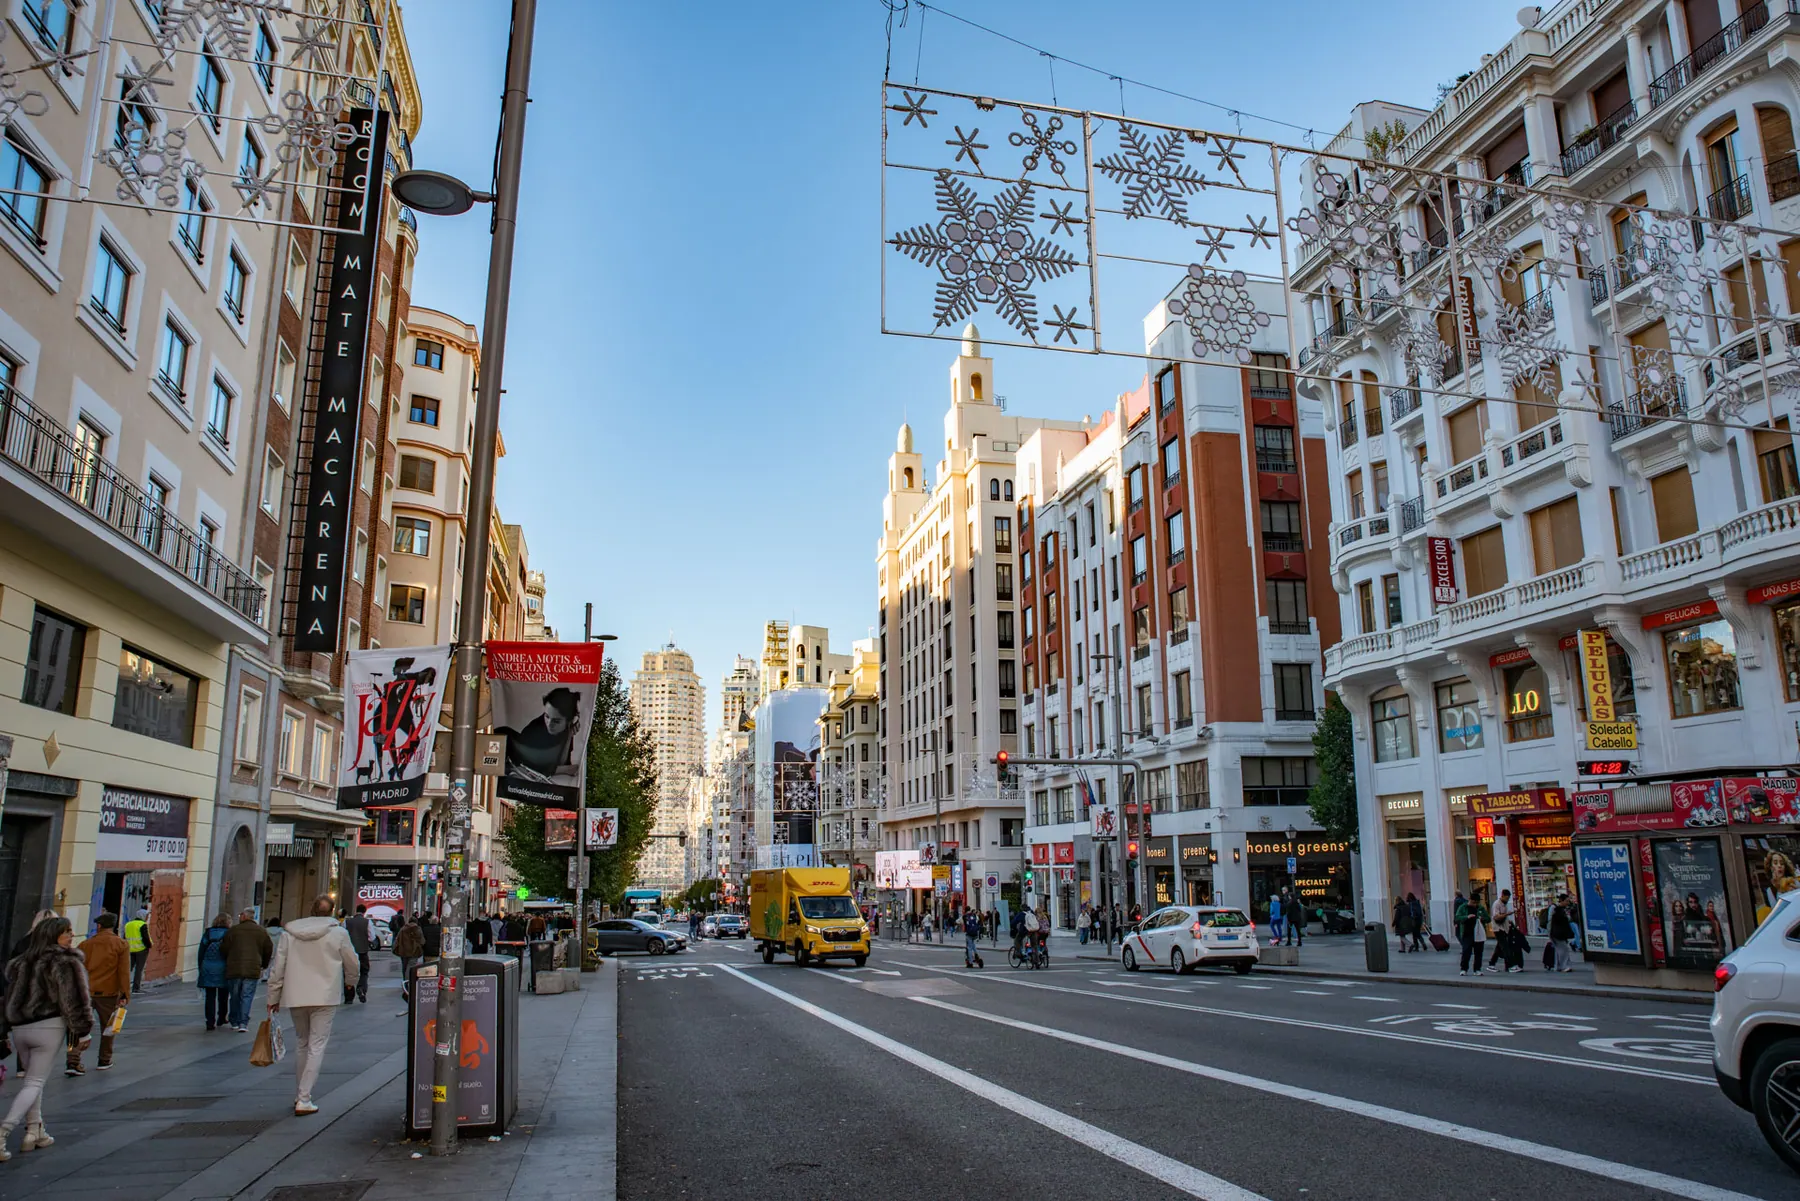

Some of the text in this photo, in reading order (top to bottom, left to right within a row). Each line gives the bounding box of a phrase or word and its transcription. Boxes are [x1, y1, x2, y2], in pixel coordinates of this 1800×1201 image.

[338, 254, 361, 358] MATE
[307, 397, 346, 636] MACARENA
[1434, 539, 1450, 588] EXCELSIOR
[1762, 583, 1788, 598] UÑAS
[1664, 605, 1701, 622] PELUCAS
[492, 653, 581, 664] ANDREA MOTIS &
[493, 662, 594, 674] BARCELONA GOSPEL
[495, 670, 559, 682] MESSENGERS
[1585, 633, 1610, 719] PELUCAS
[1590, 724, 1632, 735] Soledad
[1592, 737, 1632, 748] Cabello
[1592, 762, 1622, 774] 16:22
[1762, 779, 1797, 790] MADRID
[372, 788, 409, 800] MADRID
[508, 785, 564, 801] festivaldejazzmadrid.com
[1576, 793, 1608, 806] MADRID
[102, 792, 170, 814] COMERCIALIZADO
[1486, 794, 1531, 808] TABACOS
[147, 840, 184, 853] 917 81 00 10
[1146, 846, 1166, 857] honest
[1246, 840, 1292, 853] honest
[1584, 858, 1611, 869] Aspira
[1592, 868, 1599, 878] lo
[1600, 869, 1626, 881] mejor
[1157, 883, 1166, 892] EAT
[1157, 893, 1171, 902] REAL.
